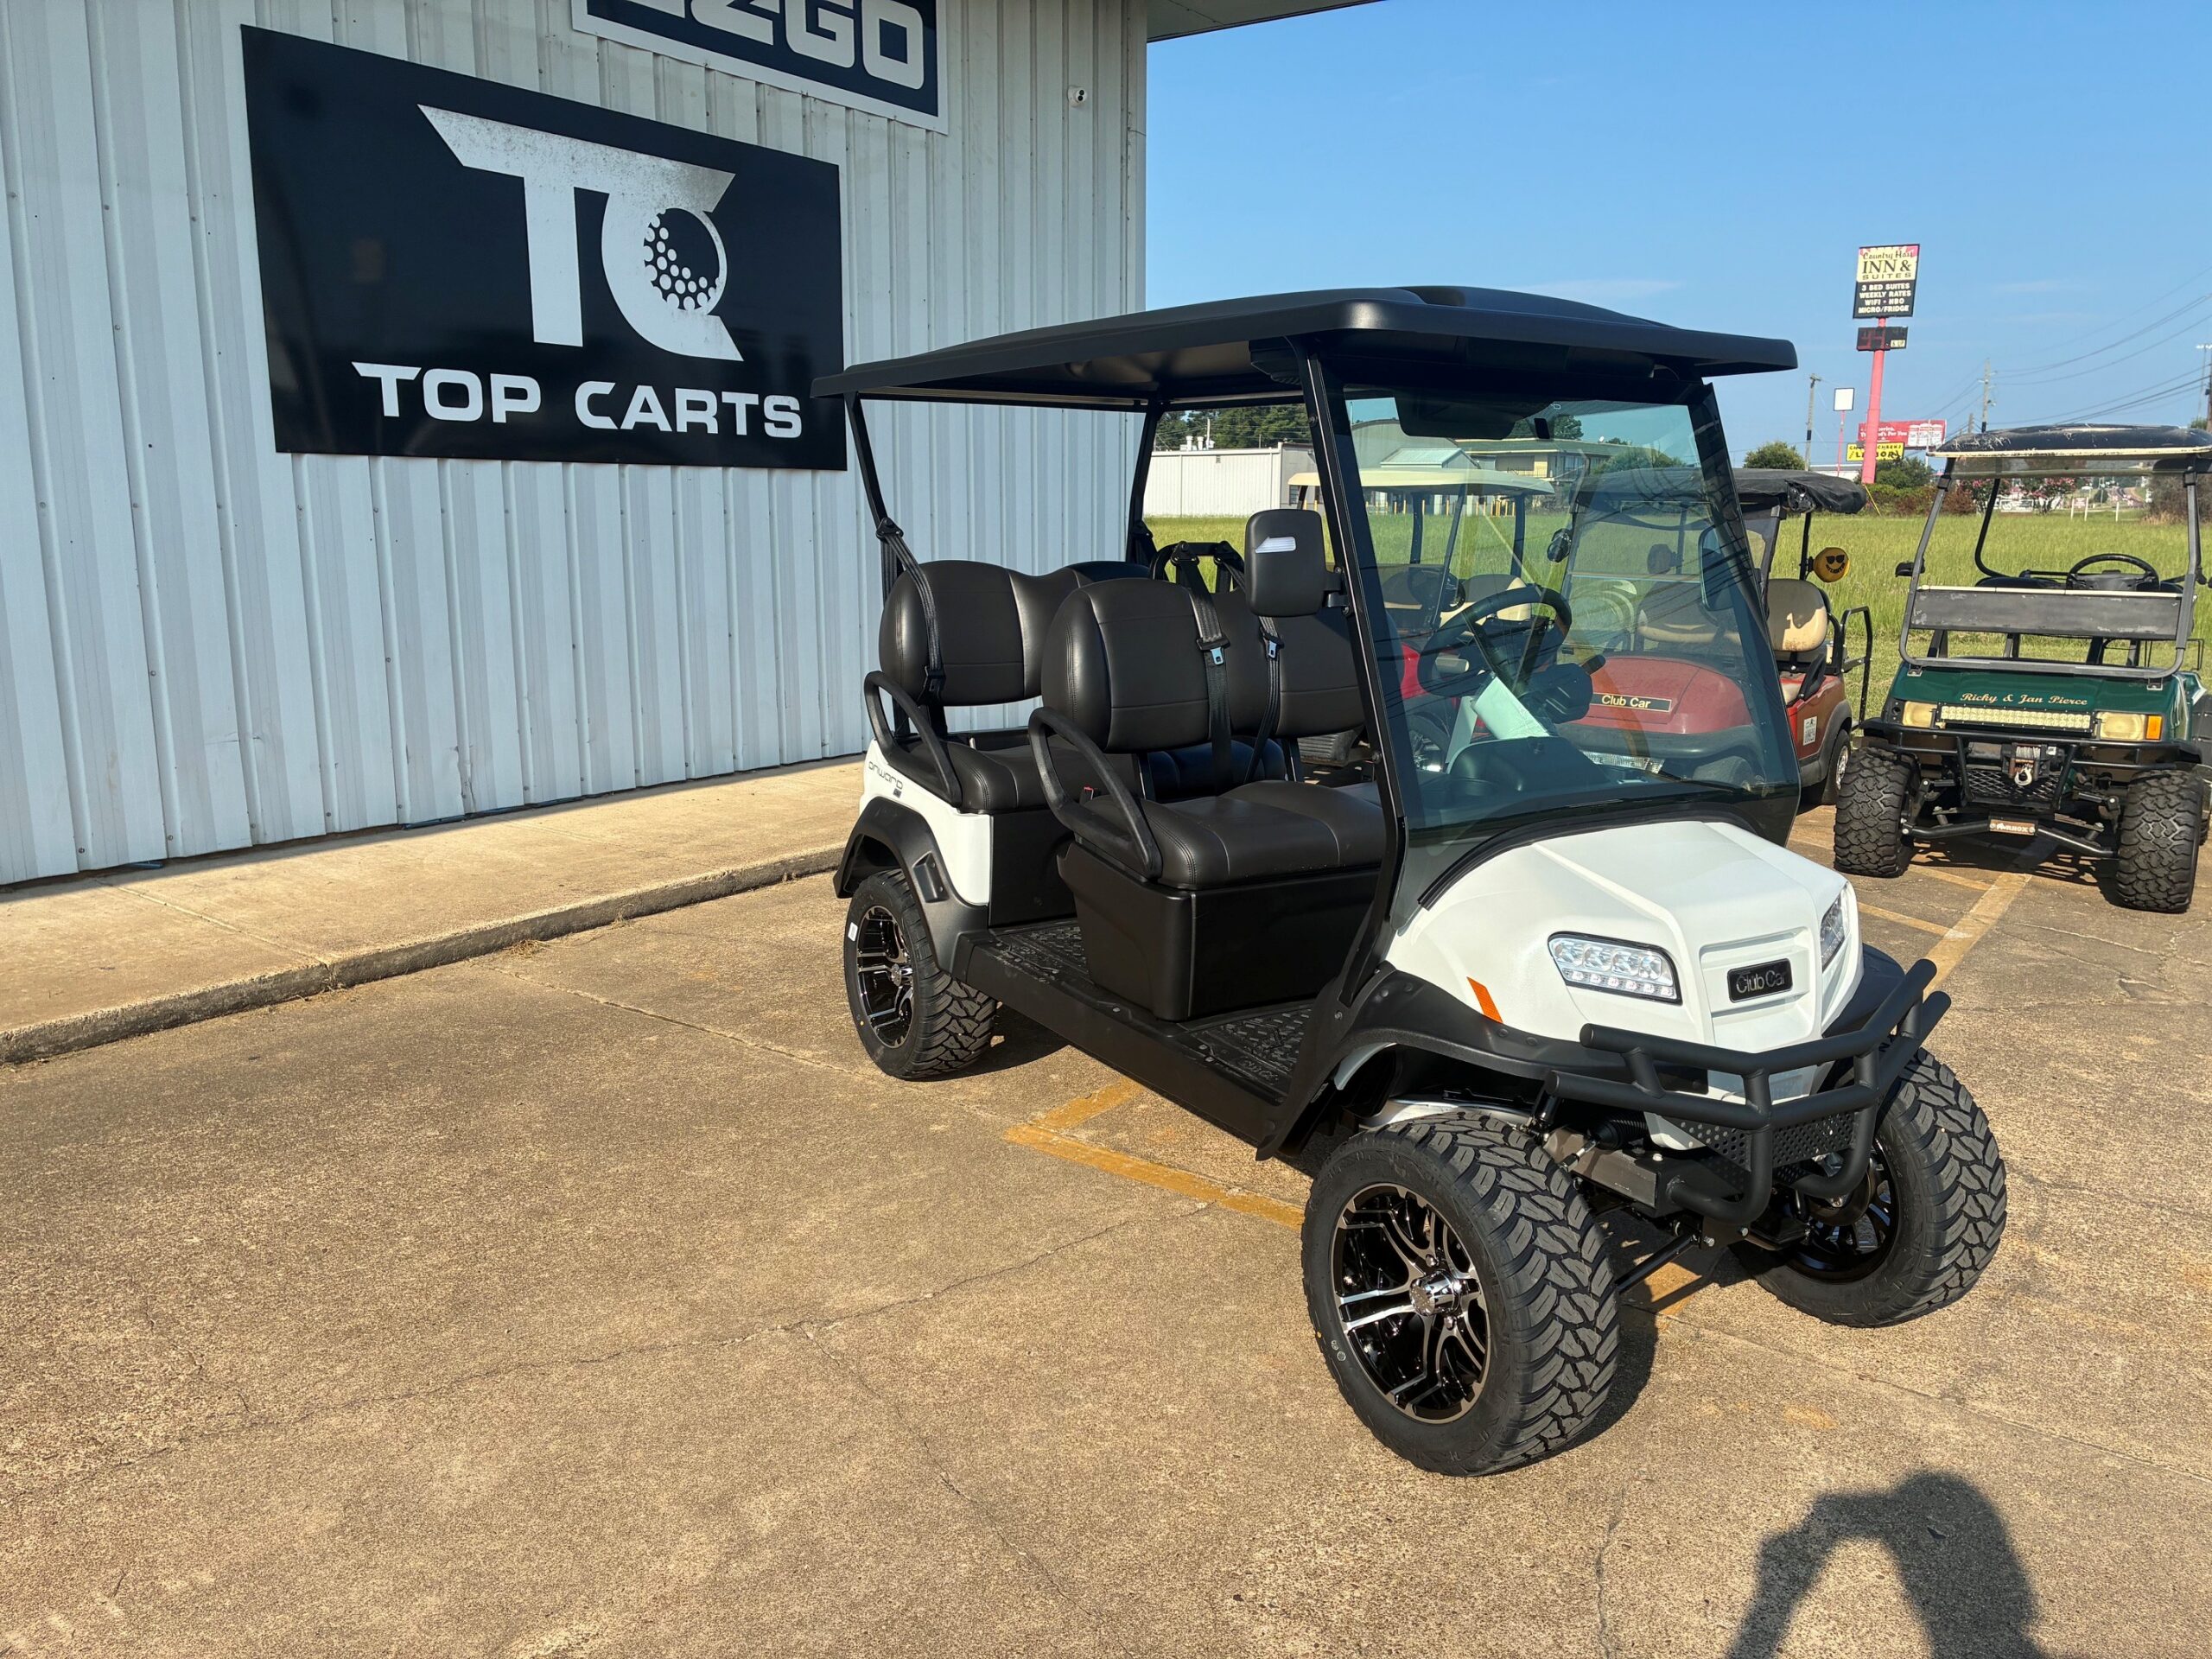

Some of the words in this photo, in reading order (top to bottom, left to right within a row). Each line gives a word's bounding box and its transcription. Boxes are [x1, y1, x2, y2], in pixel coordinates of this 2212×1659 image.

[1862, 259, 1897, 274] INN
[1899, 259, 1912, 272] &
[1862, 272, 1912, 281] SUITES
[1858, 305, 1910, 314] MICRO/FRIDGE
[351, 361, 542, 423] TOP
[575, 381, 803, 439] CARTS
[1601, 695, 1626, 706] Club
[1630, 697, 1651, 708] Car
[1960, 692, 1998, 703] Ricky
[2003, 694, 2014, 702] &
[2018, 694, 2044, 704] Jan
[2048, 695, 2088, 706] Pierce
[1736, 973, 1765, 994] Club
[1765, 969, 1787, 988] Car
